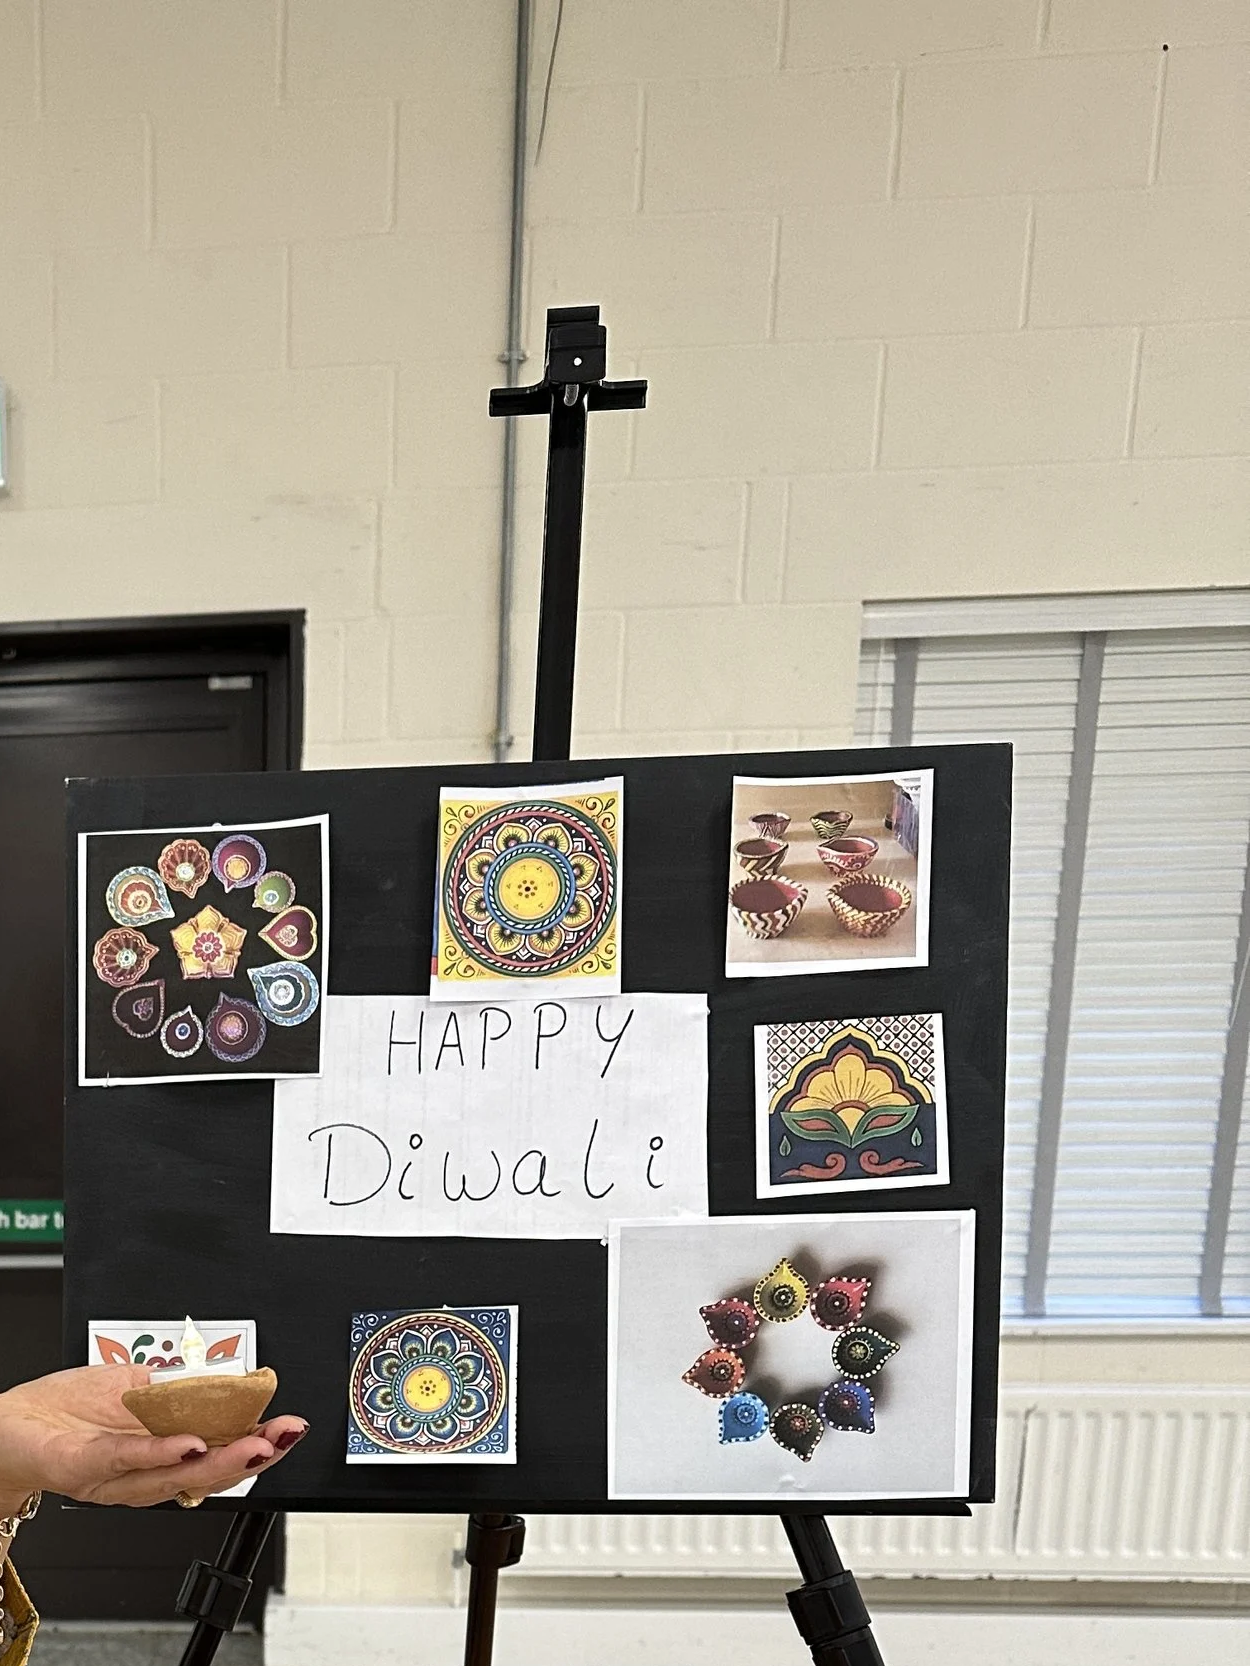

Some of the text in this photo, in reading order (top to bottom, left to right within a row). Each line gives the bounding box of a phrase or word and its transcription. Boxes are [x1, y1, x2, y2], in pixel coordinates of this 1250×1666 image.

[388, 1002, 634, 1078] HAPPY
[308, 1118, 664, 1206] Diwali
[14, 1210, 49, 1229] bar
